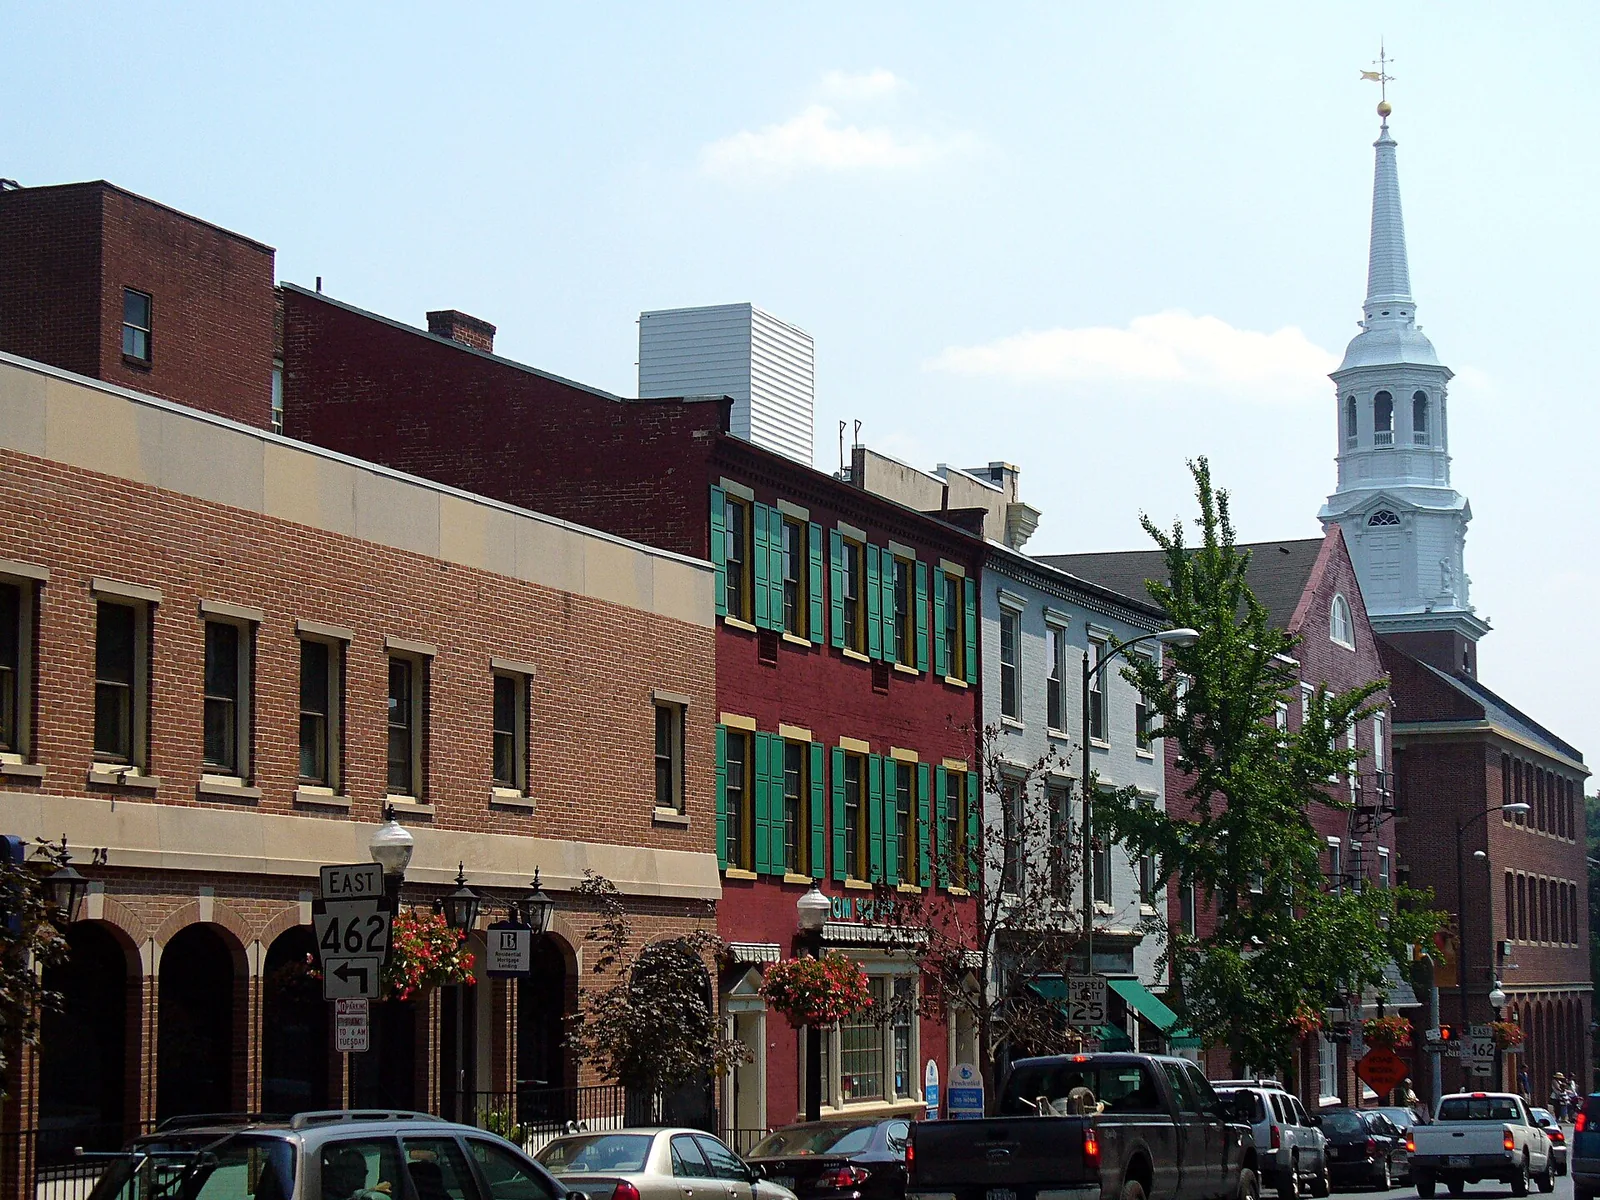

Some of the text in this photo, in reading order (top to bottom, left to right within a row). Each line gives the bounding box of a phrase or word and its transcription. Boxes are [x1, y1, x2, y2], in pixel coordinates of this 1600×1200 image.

[329, 871, 374, 894] EAST
[320, 914, 385, 953] 462
[1071, 981, 1105, 990] SPEED
[336, 1001, 346, 1013] NO
[1072, 1001, 1104, 1020] 25
[339, 1028, 347, 1036] TO
[357, 1028, 367, 1036] AM
[1472, 1027, 1490, 1036] EAST
[339, 1038, 366, 1046] TUESDAY
